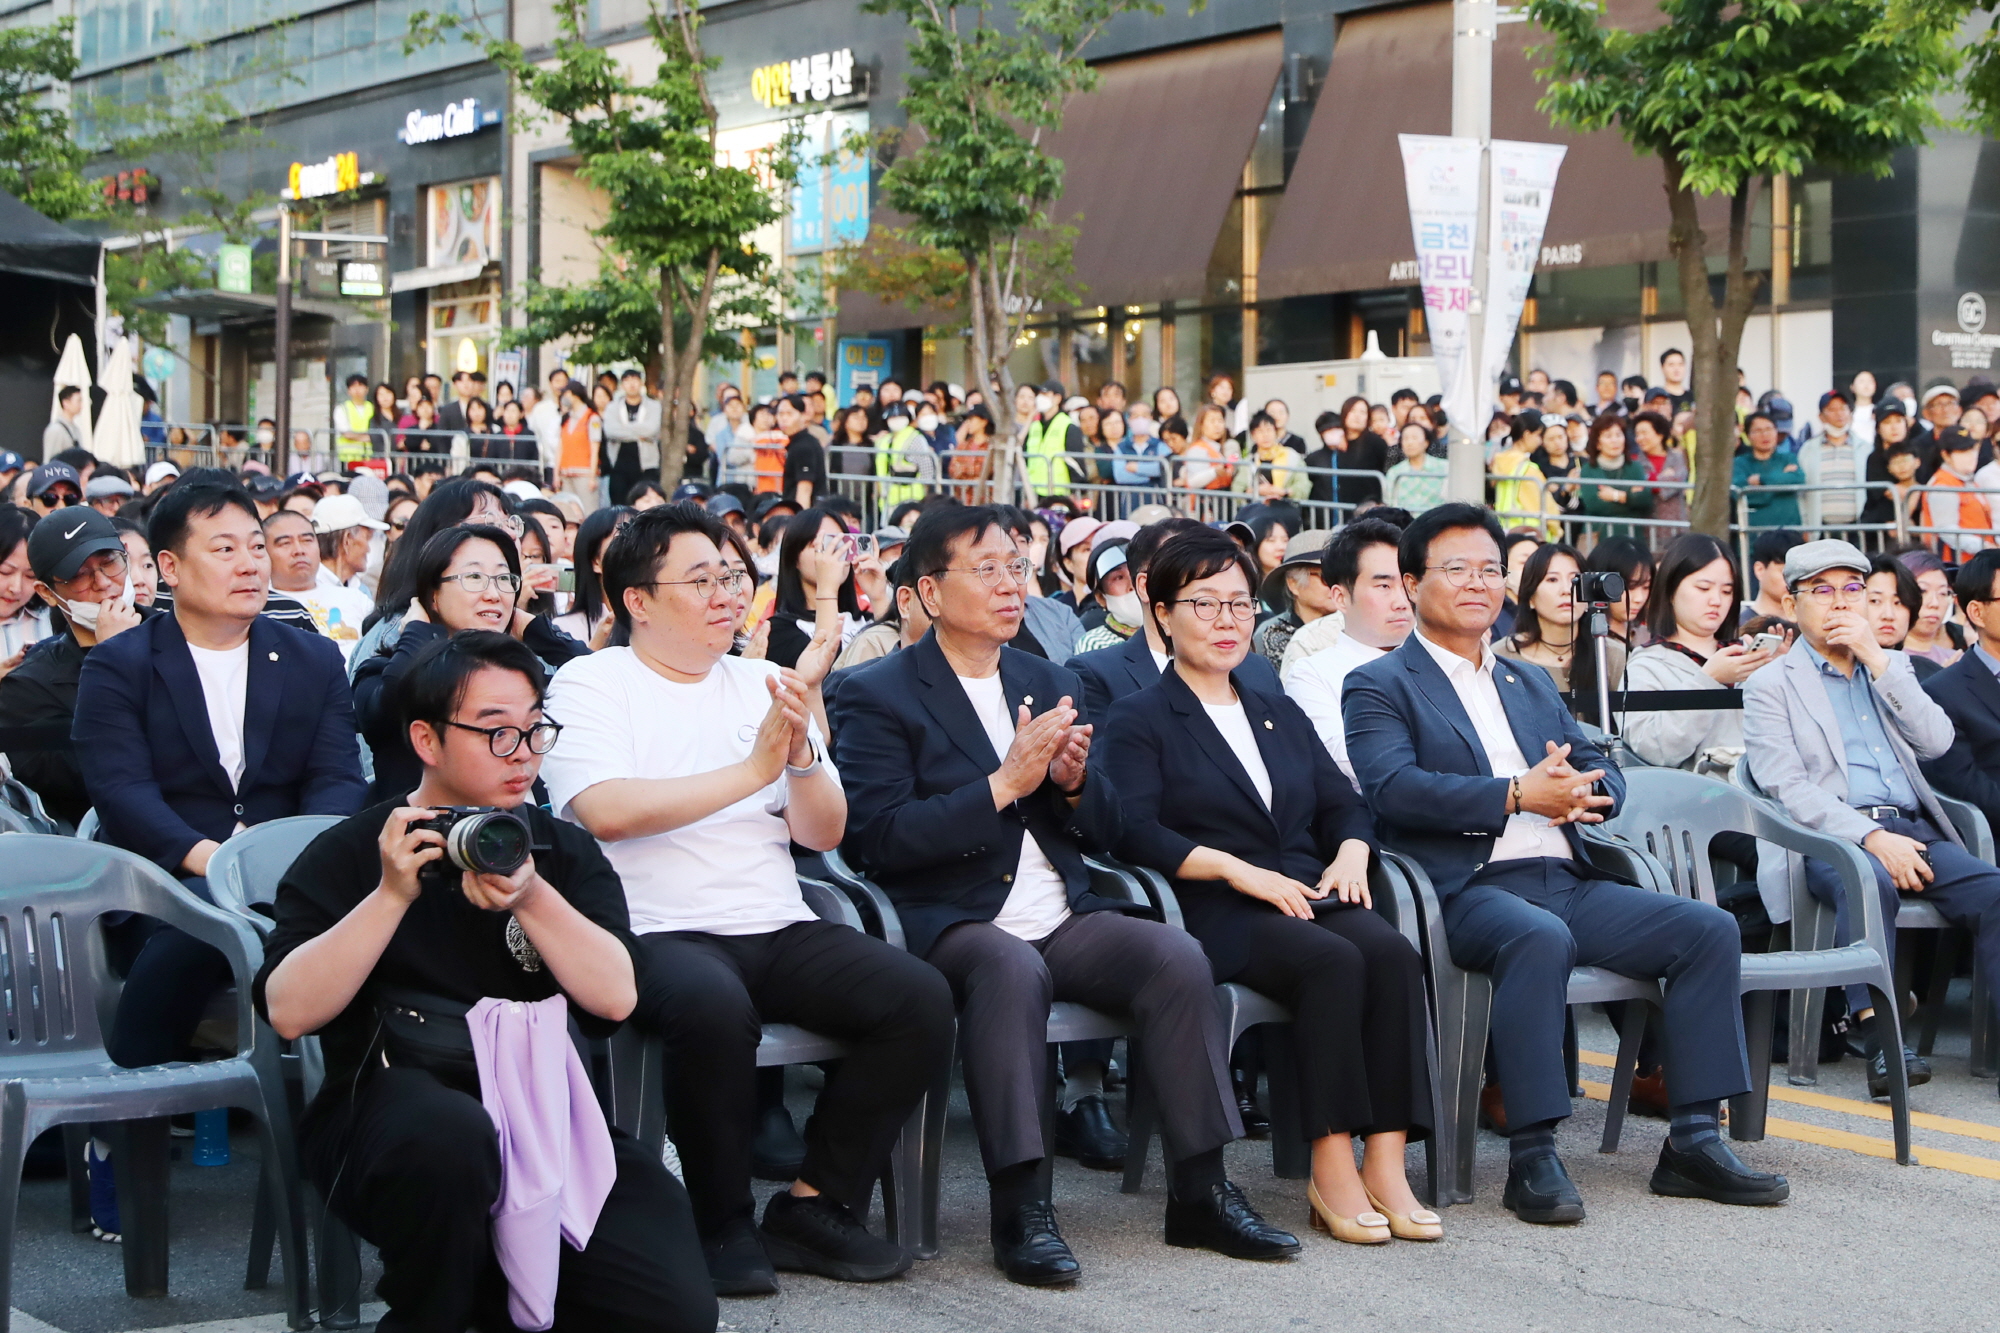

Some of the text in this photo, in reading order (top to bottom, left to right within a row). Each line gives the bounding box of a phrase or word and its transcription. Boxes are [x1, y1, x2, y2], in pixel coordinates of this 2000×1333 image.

[751, 48, 854, 109] 이안부동산
[1421, 222, 1470, 250] 금천
[1541, 243, 1583, 266] PARIS
[1422, 285, 1470, 313] 축제
